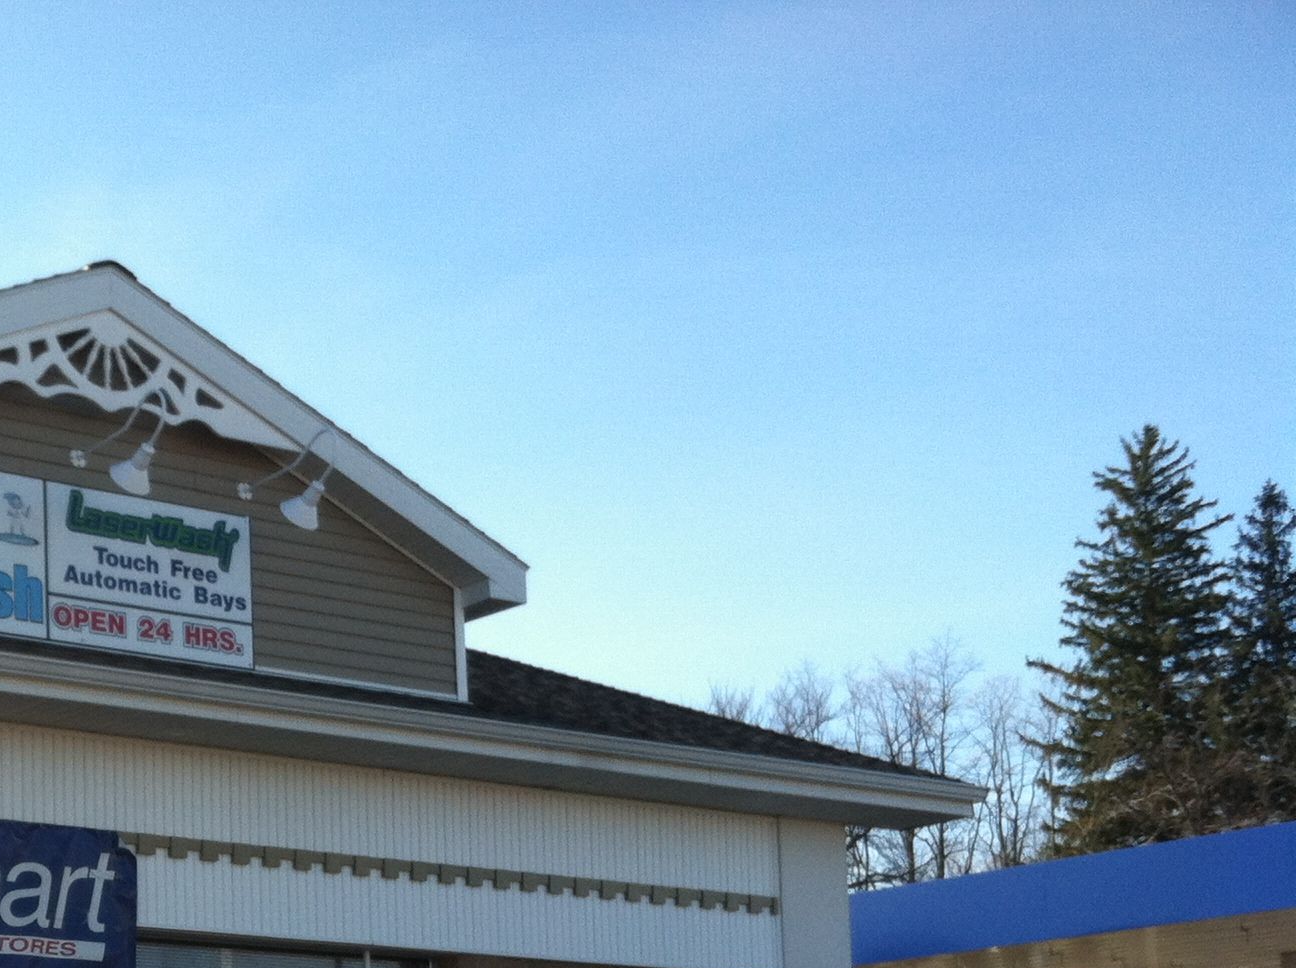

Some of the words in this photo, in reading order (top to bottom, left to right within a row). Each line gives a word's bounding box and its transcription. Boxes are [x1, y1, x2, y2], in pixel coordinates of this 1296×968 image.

[64, 564, 182, 600] Automatic
[194, 586, 247, 612] Bays
[93, 545, 159, 574] Touch
[170, 558, 218, 584] Free
[52, 604, 127, 637] OPEN
[137, 617, 173, 643] 24
[183, 624, 244, 654] HRS.
